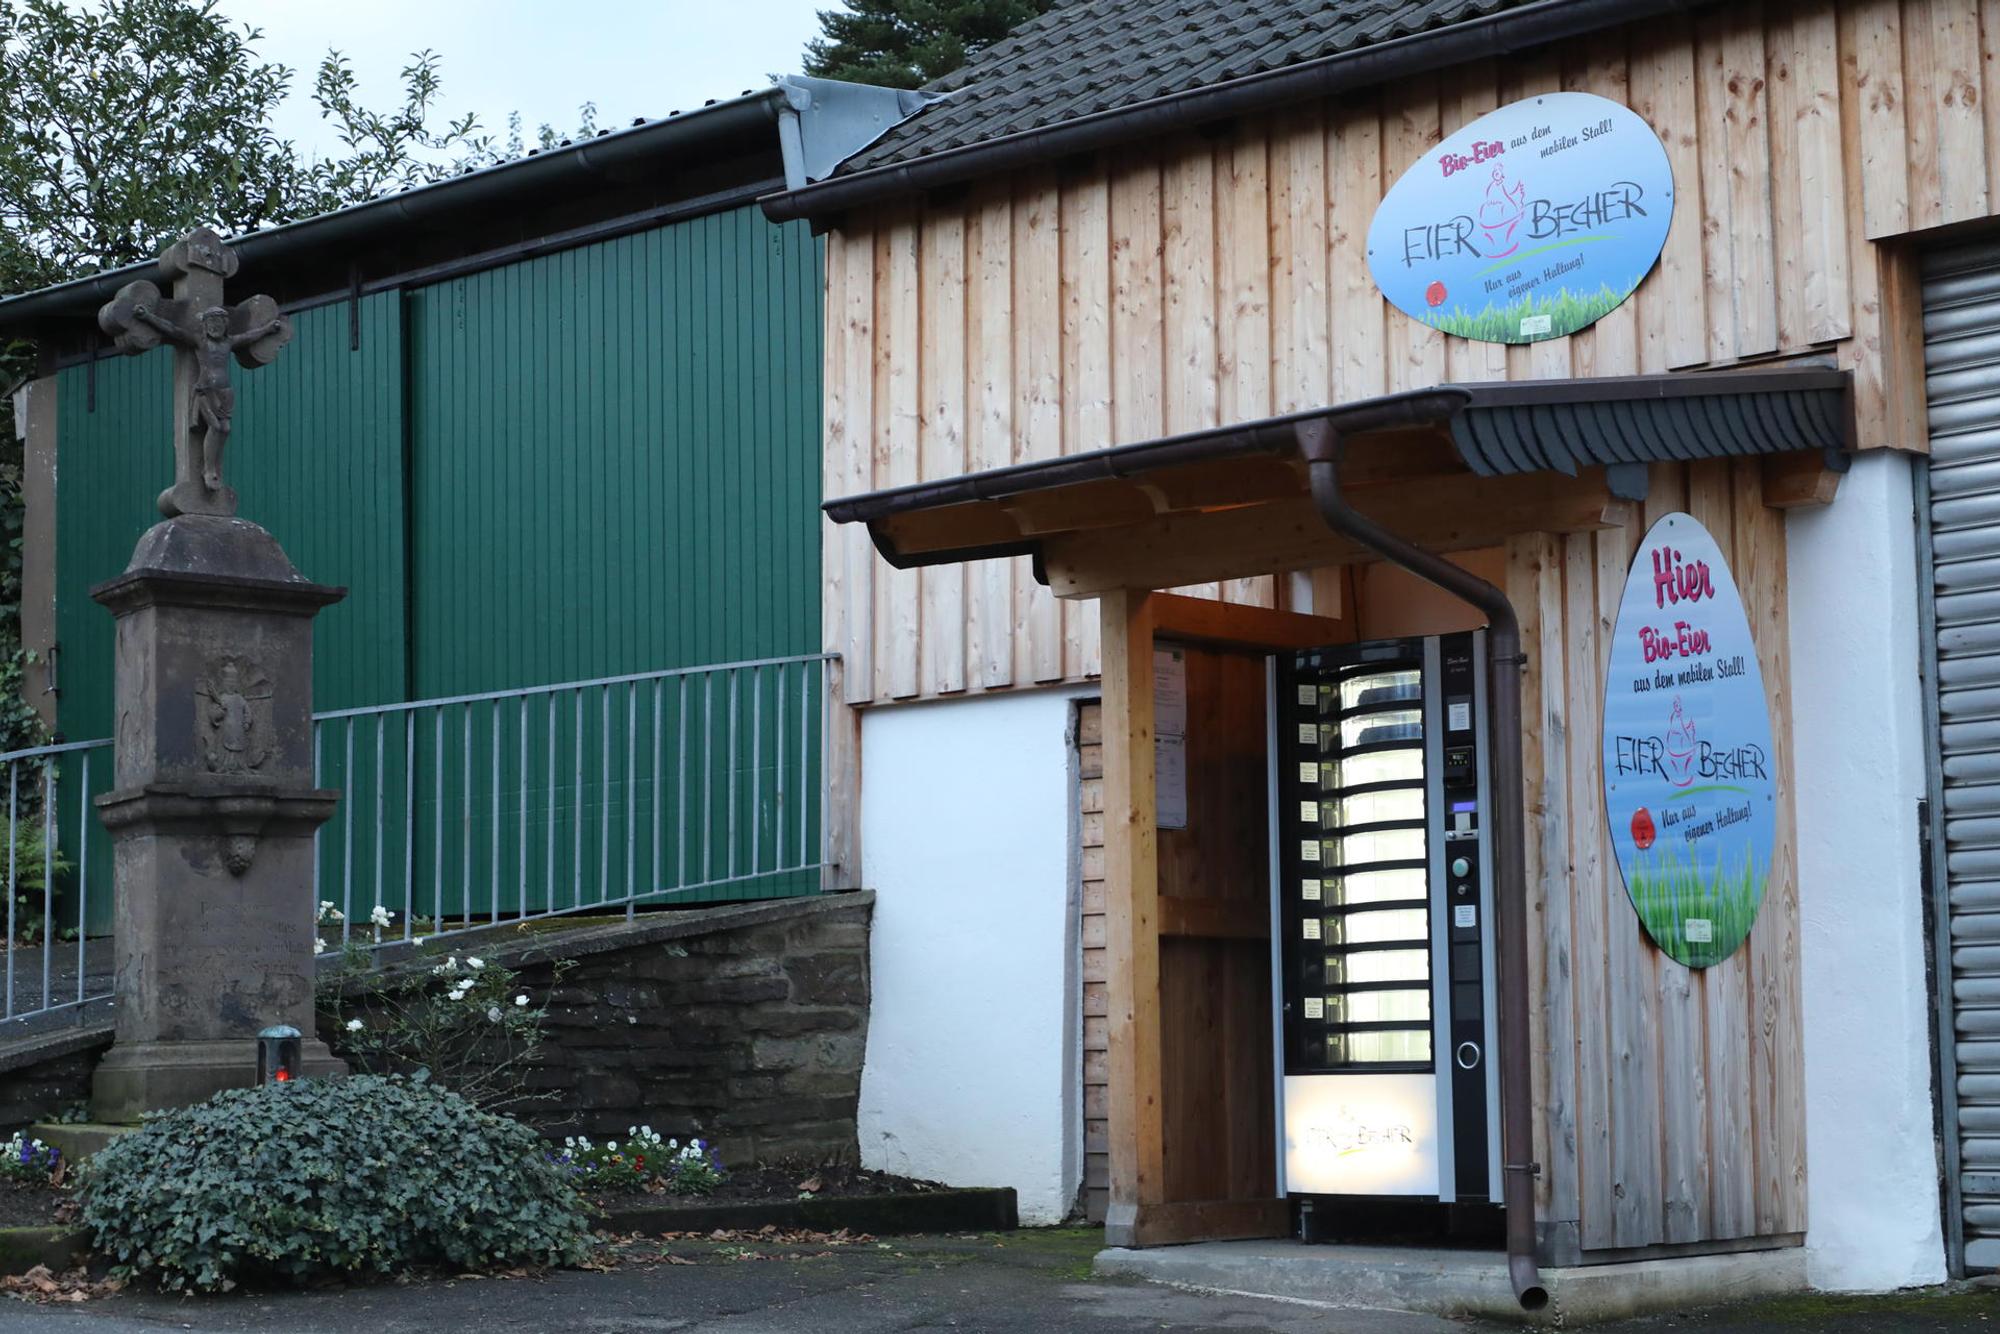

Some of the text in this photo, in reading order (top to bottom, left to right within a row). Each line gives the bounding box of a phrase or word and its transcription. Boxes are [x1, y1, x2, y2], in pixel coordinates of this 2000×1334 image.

[1439, 125, 1552, 177] Bio-Eier aus dem
[1540, 118, 1613, 159] mobilen Stall!
[1402, 181, 1648, 268] EIER BECHER
[1484, 270, 1522, 294] Nur aus
[1508, 253, 1585, 298] eigener Haltung!
[1652, 546, 1715, 609] Hier
[1639, 621, 1711, 663] Bio-Eier
[1634, 656, 1745, 693] aus dem mobilen Stall!
[1615, 735, 1767, 782] EIER BECHER
[1661, 809, 1679, 829] Nur
[1682, 805, 1696, 821] aus
[1684, 800, 1752, 843] eigener Haltung!
